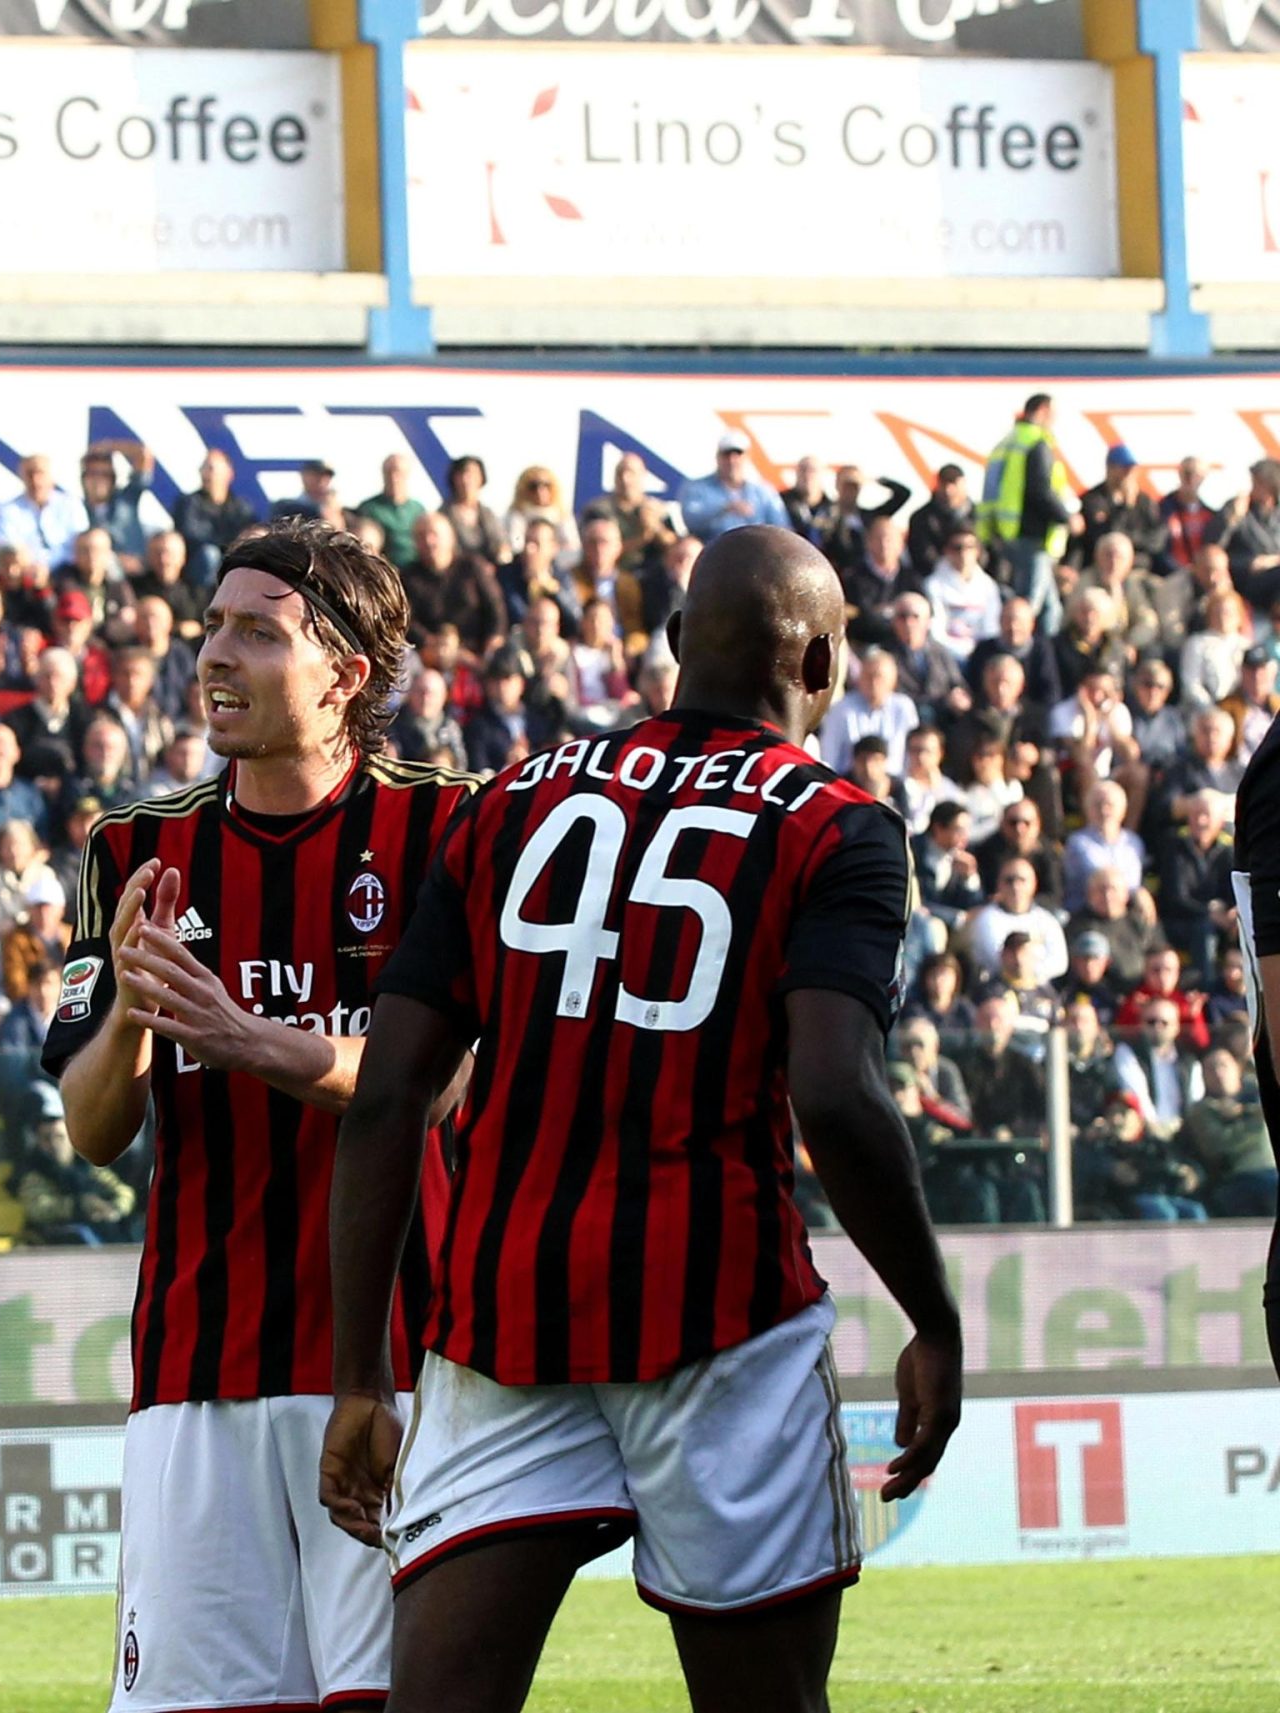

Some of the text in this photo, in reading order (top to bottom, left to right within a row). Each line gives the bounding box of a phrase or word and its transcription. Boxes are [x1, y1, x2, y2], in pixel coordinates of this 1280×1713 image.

[55, 95, 309, 164] Coffee
[582, 101, 1083, 172] Lino's Coffee
[174, 926, 213, 943] didas
[500, 792, 759, 1032] 45
[238, 959, 315, 1004] Fly
